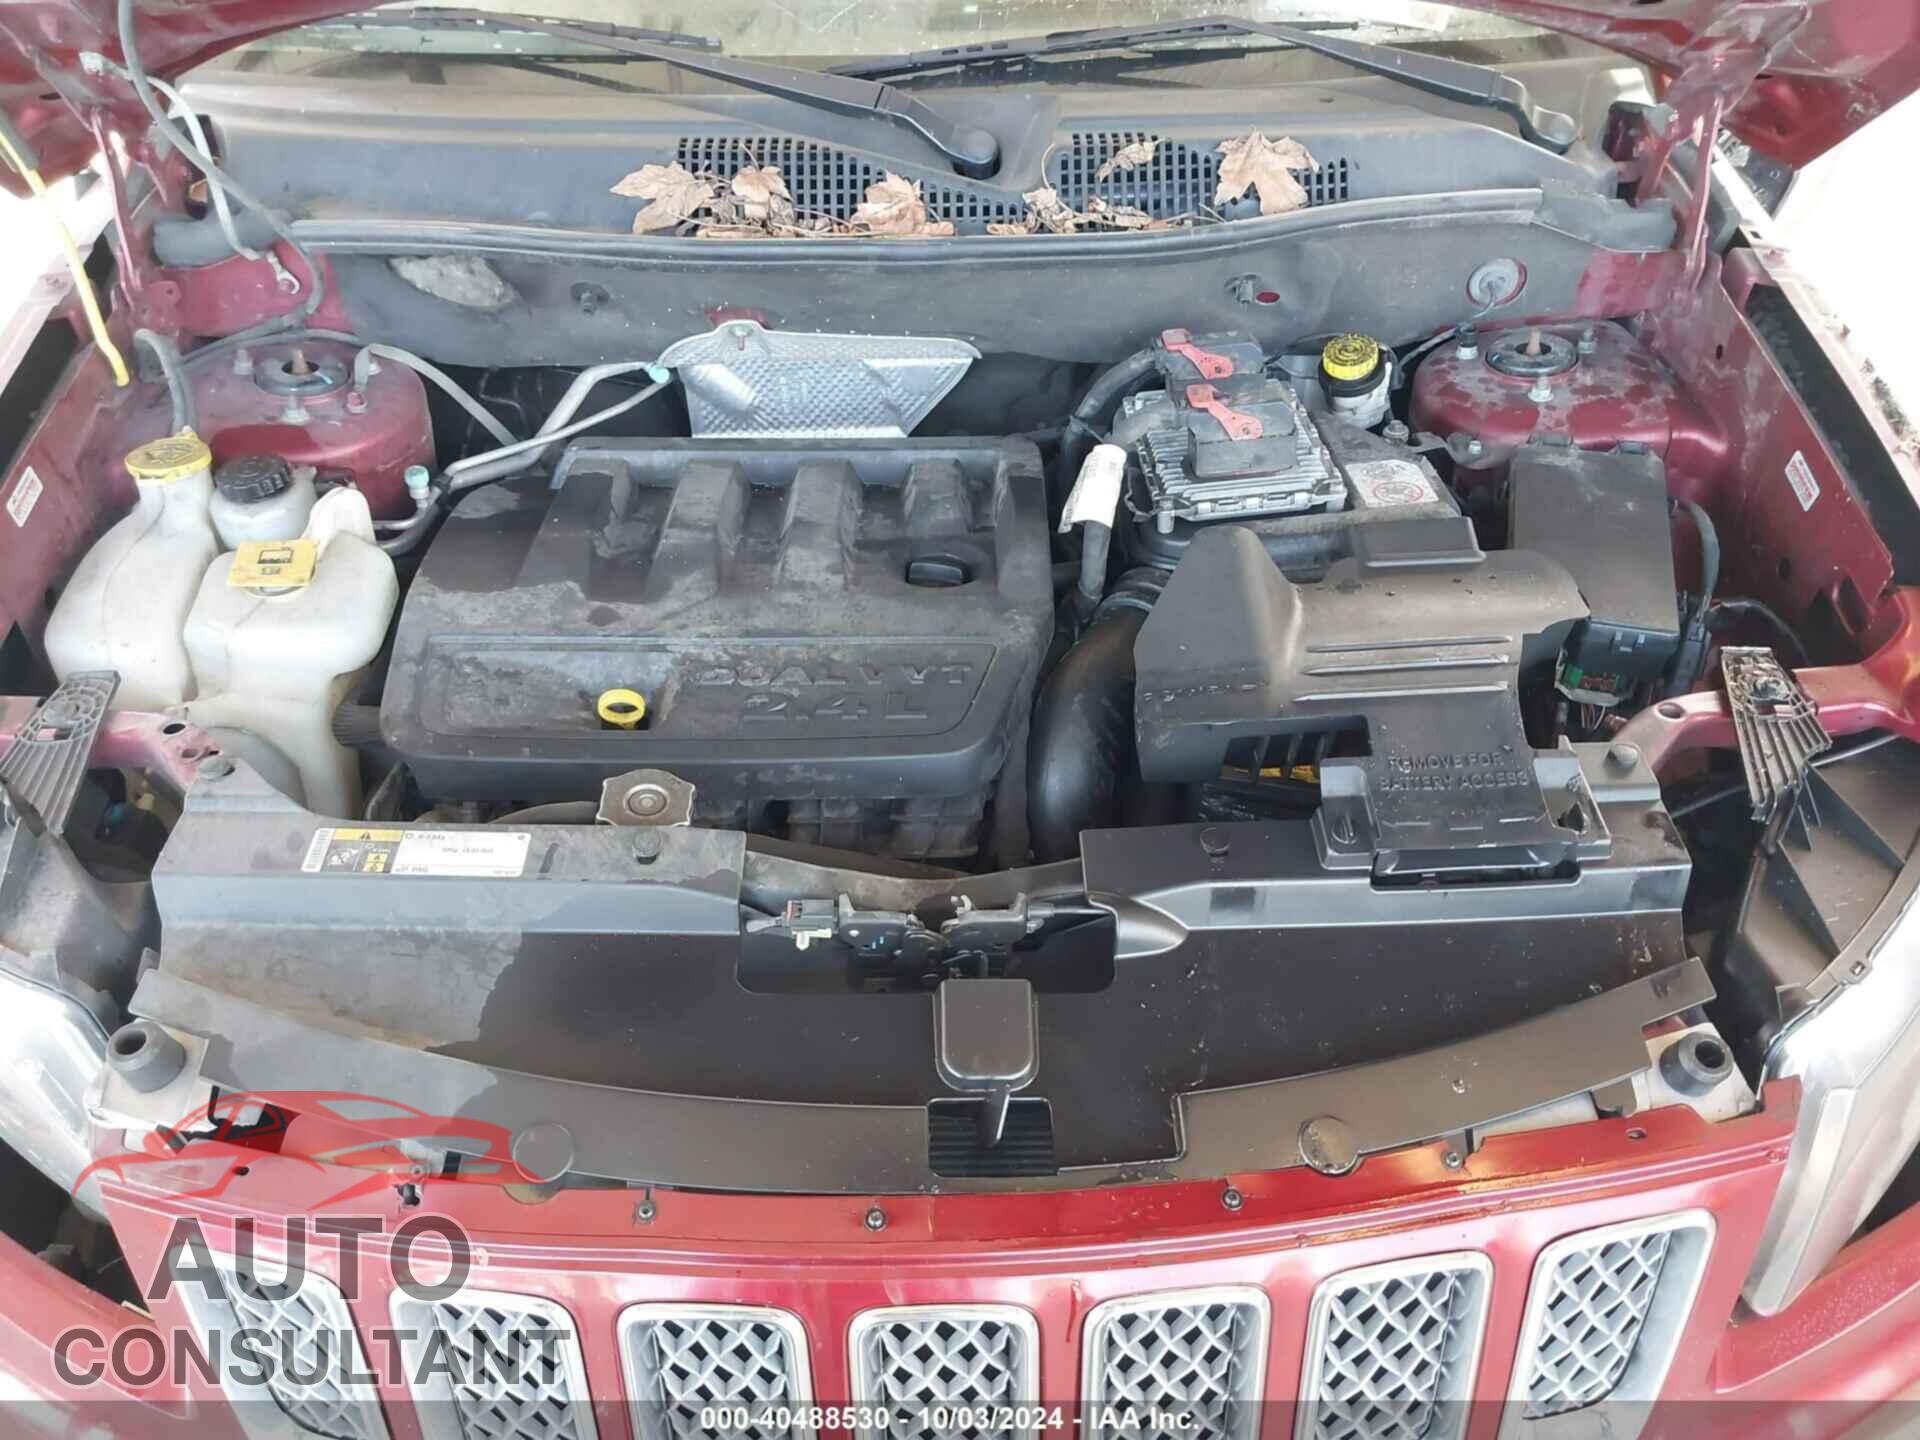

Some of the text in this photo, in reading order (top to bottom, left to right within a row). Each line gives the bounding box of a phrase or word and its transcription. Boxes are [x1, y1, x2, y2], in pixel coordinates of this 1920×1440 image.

[856, 663, 974, 686] VVT
[741, 690, 930, 720] 2.4L
[1388, 752, 1505, 773] REMOVE FOR
[1379, 771, 1530, 792] BATTERY ACCESS
